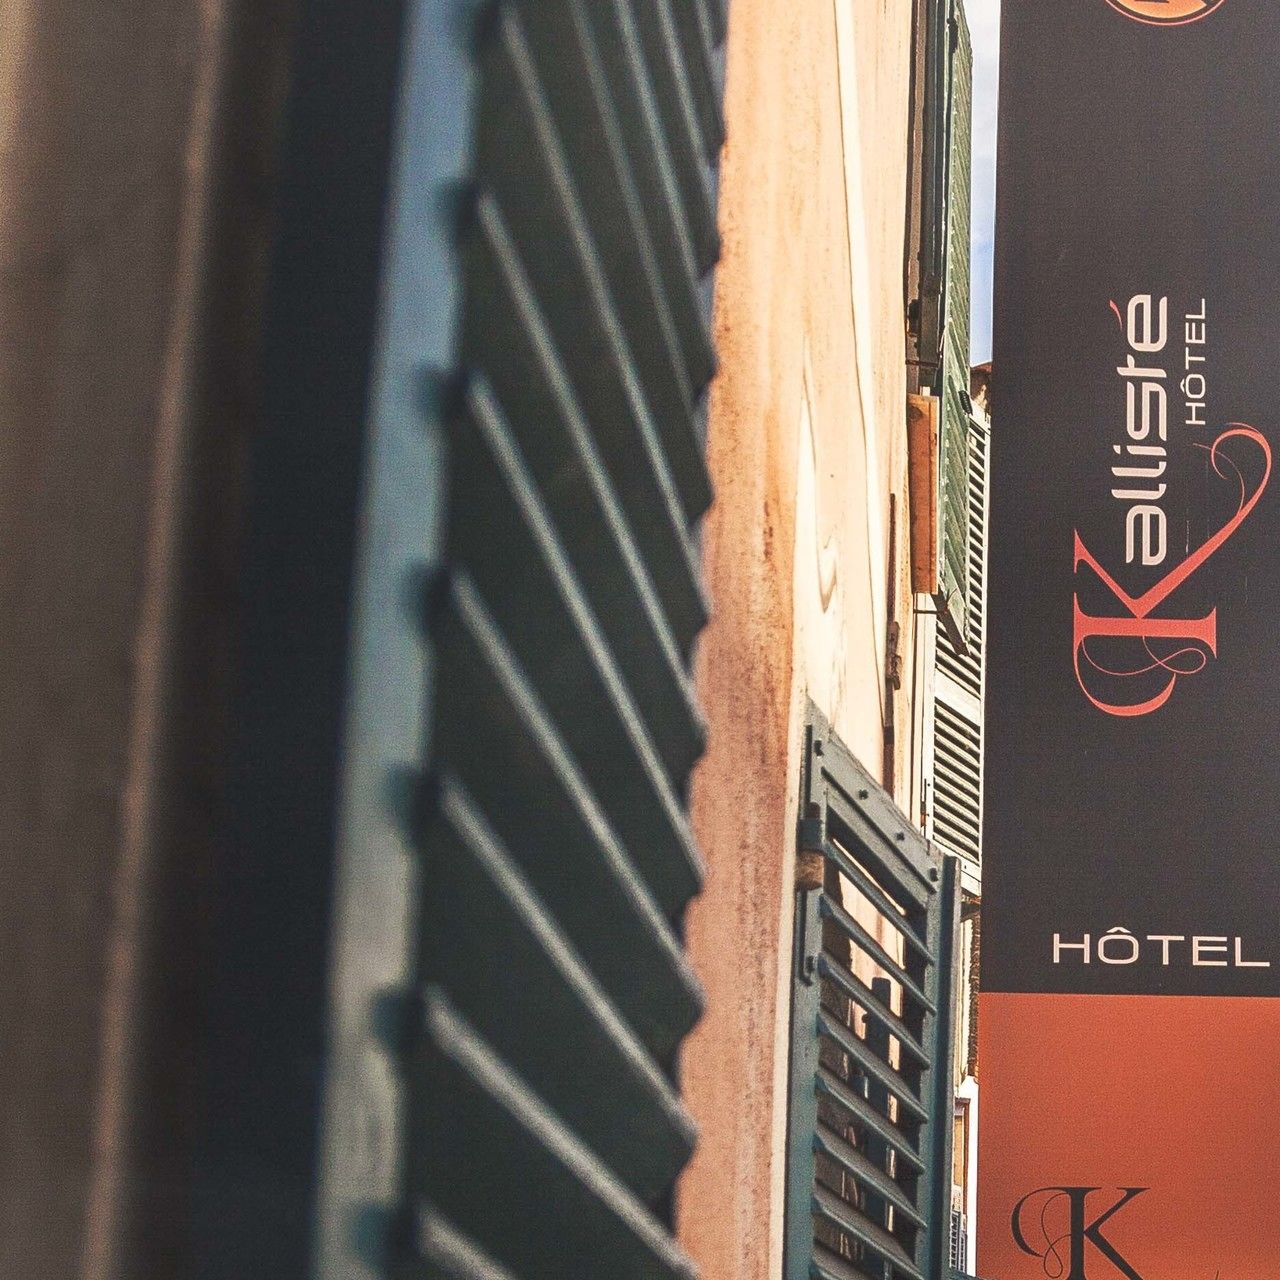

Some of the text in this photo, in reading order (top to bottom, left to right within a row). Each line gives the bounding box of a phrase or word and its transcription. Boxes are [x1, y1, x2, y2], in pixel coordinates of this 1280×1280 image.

[1180, 297, 1206, 425] HÔTEL
[1073, 293, 1272, 717] Kallisté
[1052, 926, 1271, 968] HÔTEL
